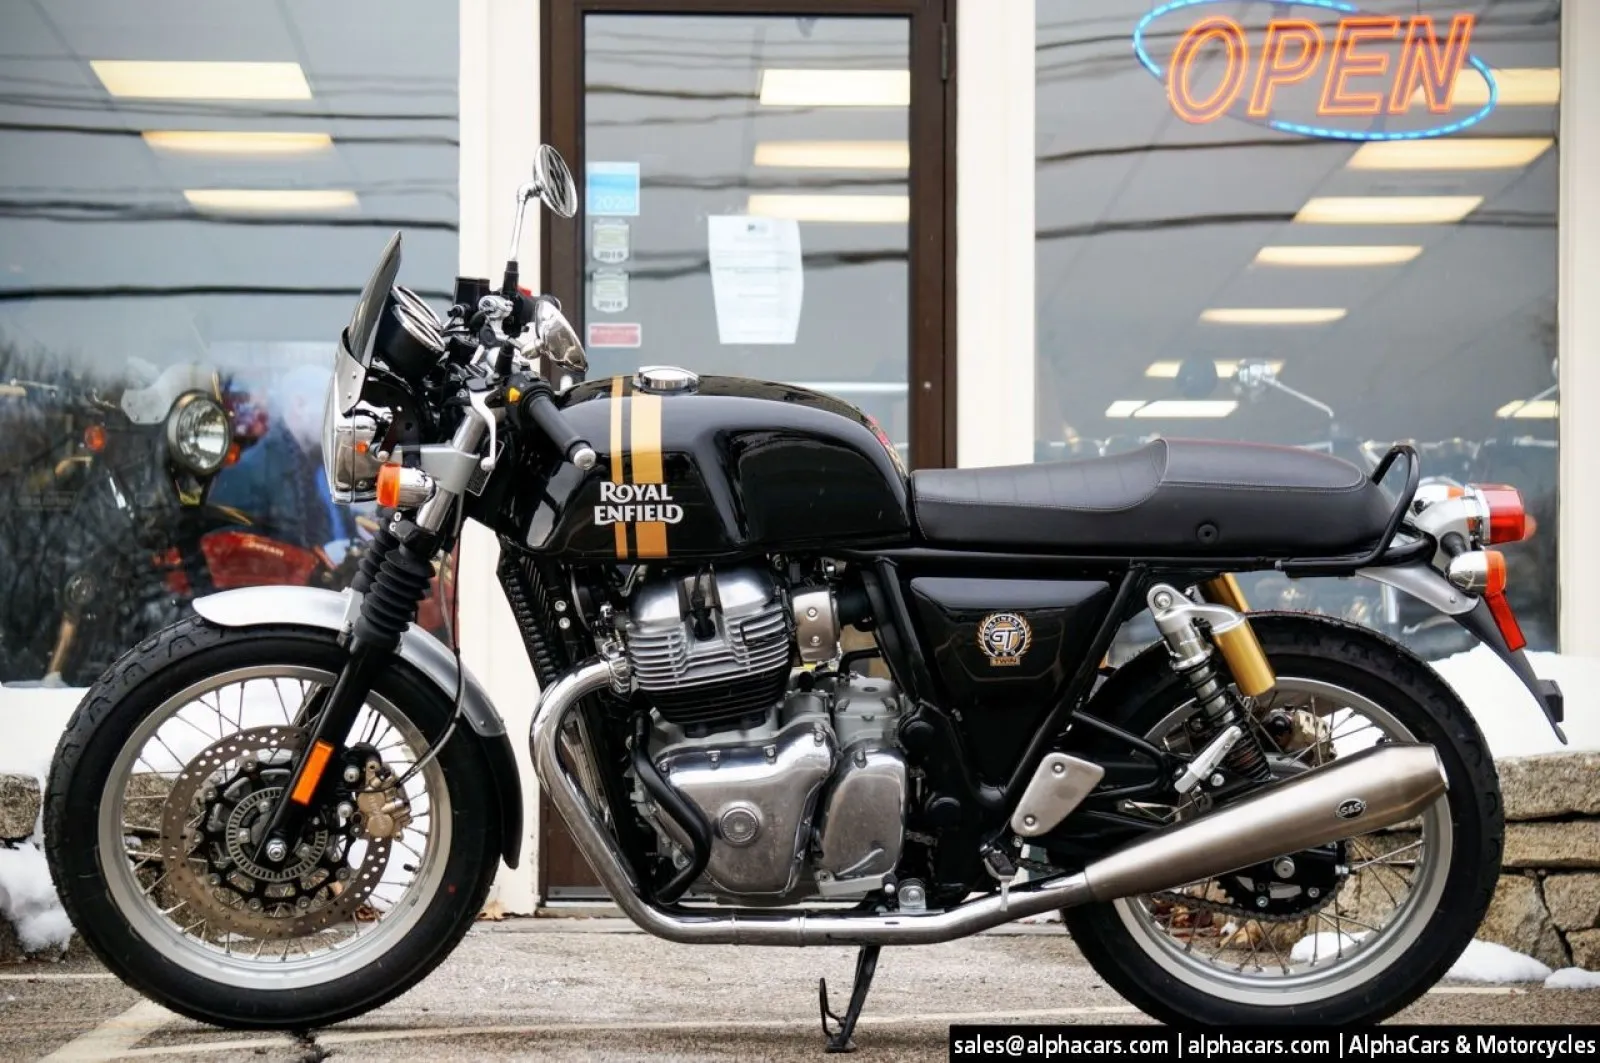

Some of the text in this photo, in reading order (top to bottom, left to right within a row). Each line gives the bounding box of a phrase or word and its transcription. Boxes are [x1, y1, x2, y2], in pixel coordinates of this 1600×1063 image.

[1168, 14, 1475, 124] OPEN
[600, 481, 673, 503] ROYAL
[594, 504, 684, 525] ENFIELD
[990, 627, 1019, 651] GT
